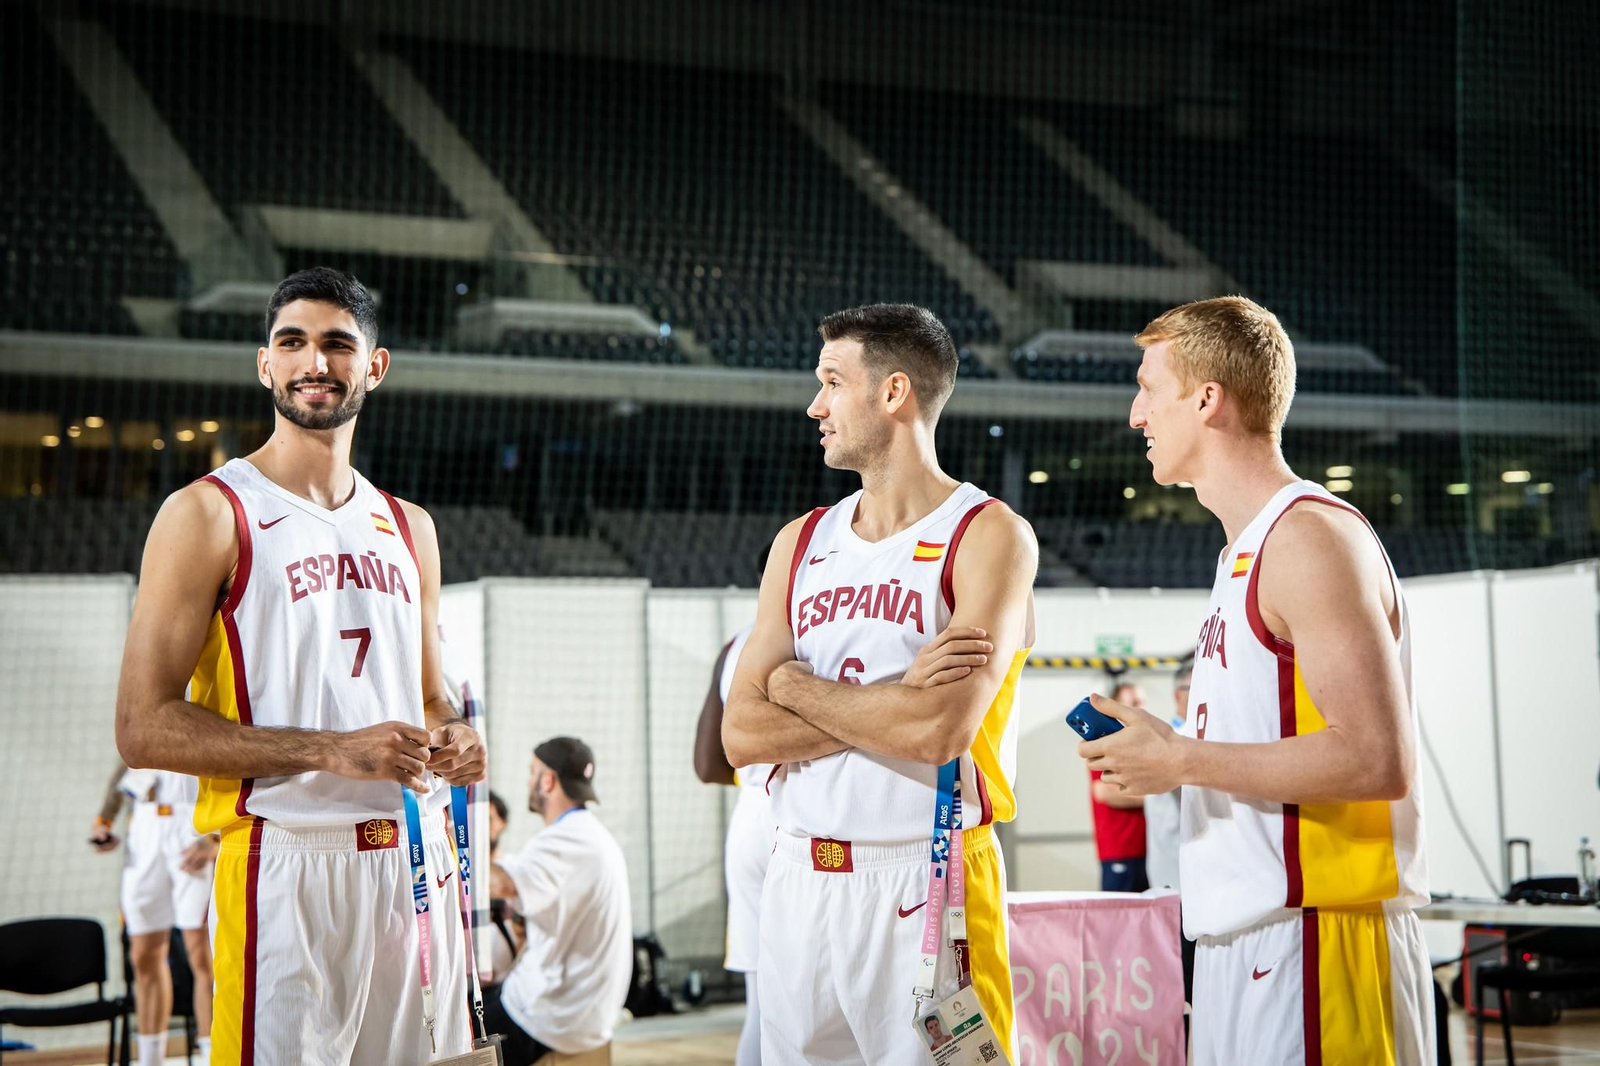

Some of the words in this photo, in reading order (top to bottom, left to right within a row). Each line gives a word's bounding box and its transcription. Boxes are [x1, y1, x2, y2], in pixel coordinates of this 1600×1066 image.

[285, 550, 411, 604] ESPAÑA
[797, 578, 924, 639] ESPAÑA
[339, 627, 372, 678] 7
[930, 883, 941, 913] 2024
[927, 916, 938, 950] PARIS
